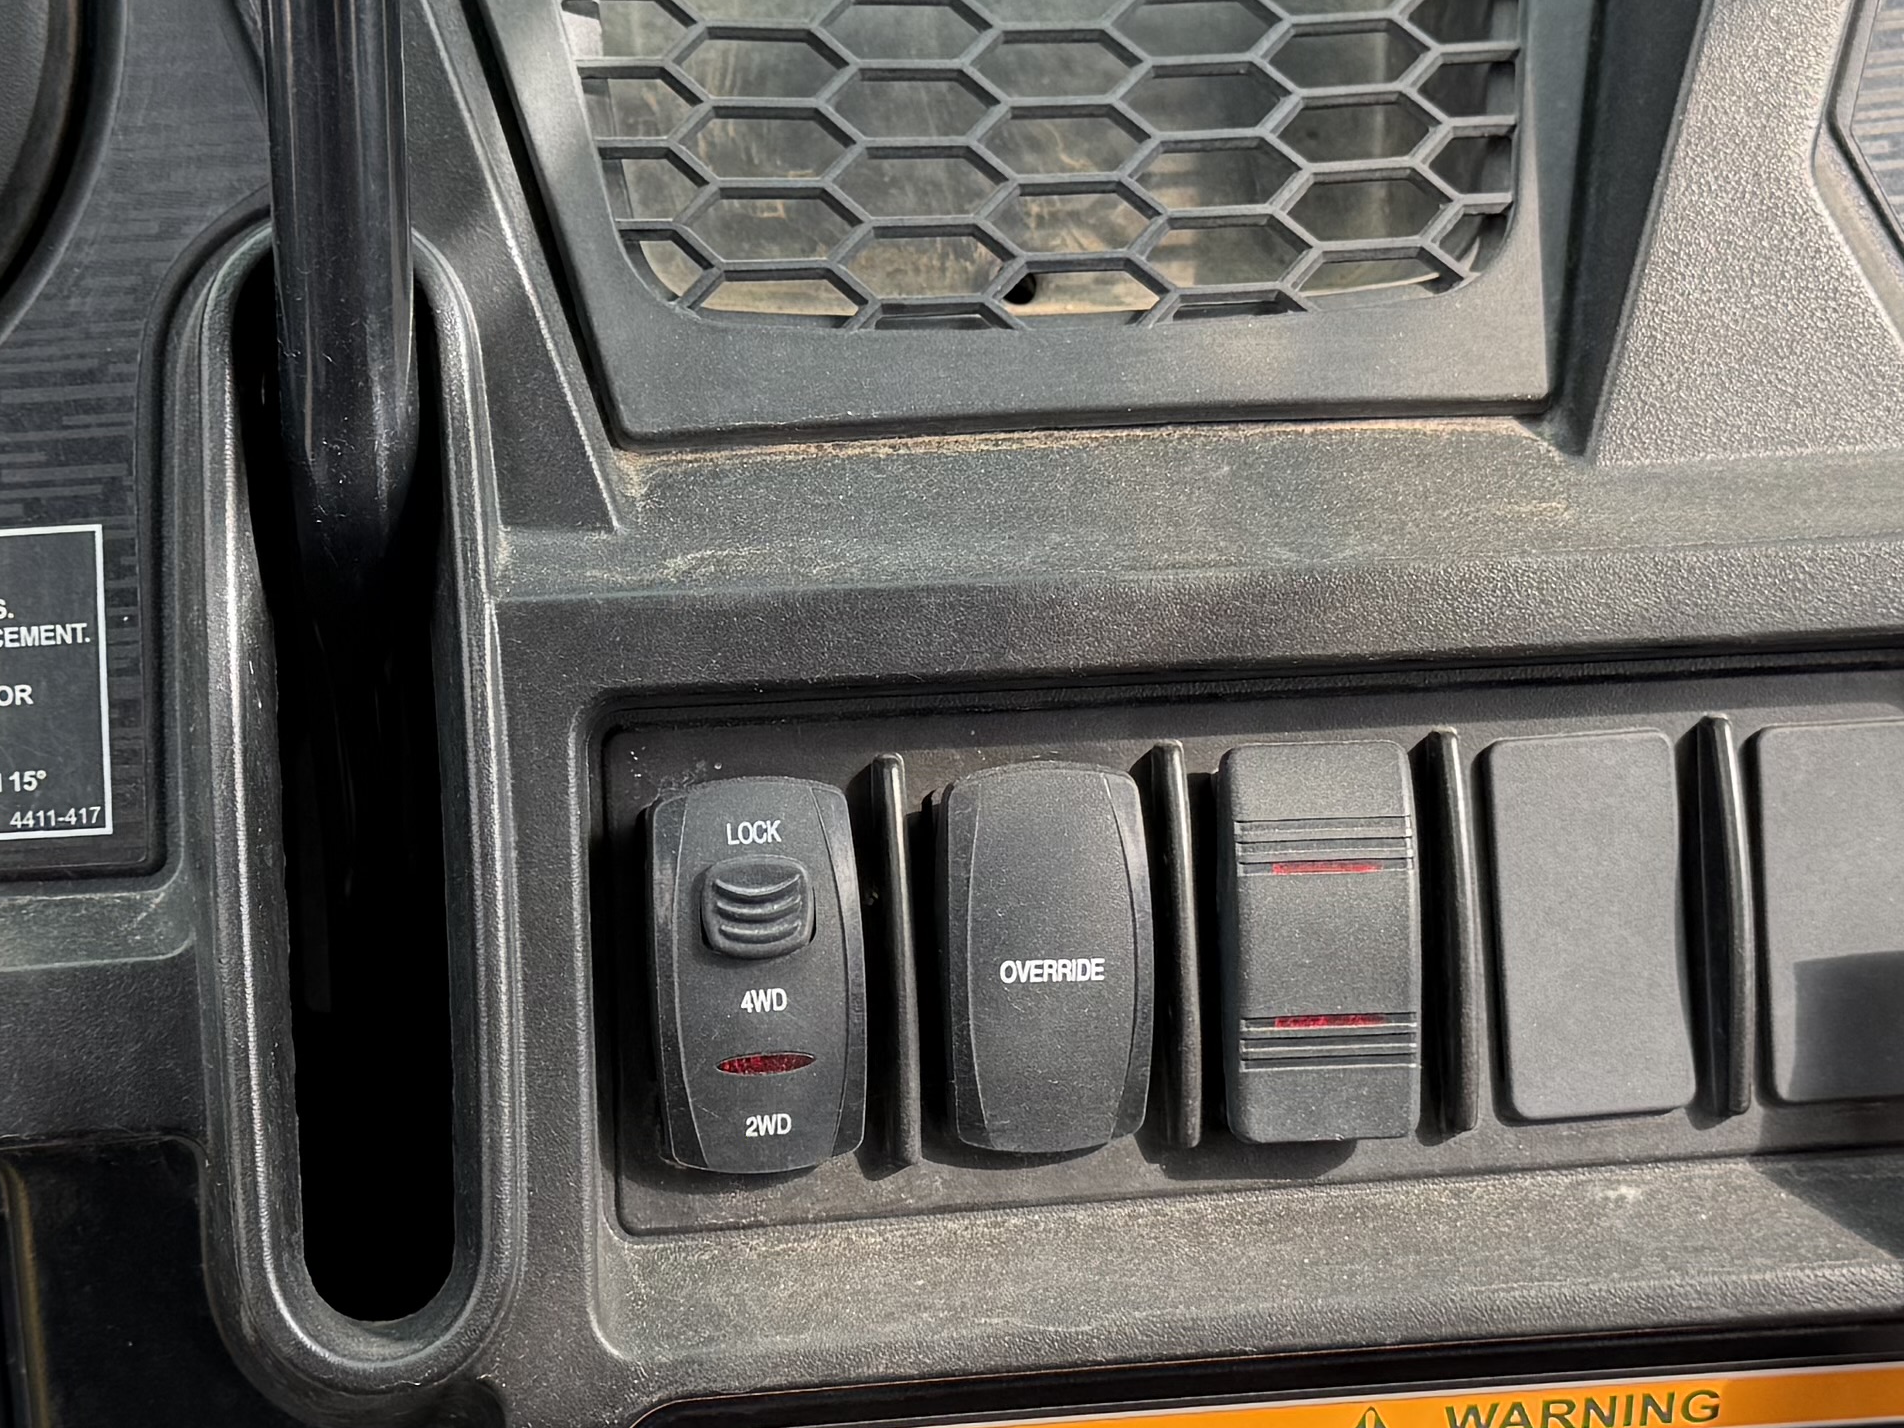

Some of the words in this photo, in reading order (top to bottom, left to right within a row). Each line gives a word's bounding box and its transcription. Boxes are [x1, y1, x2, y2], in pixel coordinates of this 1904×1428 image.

[8, 770, 47, 792] 15°
[9, 806, 101, 829] 4411-417
[726, 820, 782, 846] LOCK
[999, 957, 1105, 984] OVERRIDE
[740, 988, 787, 1013] 4WD
[745, 1113, 792, 1138] 2WD
